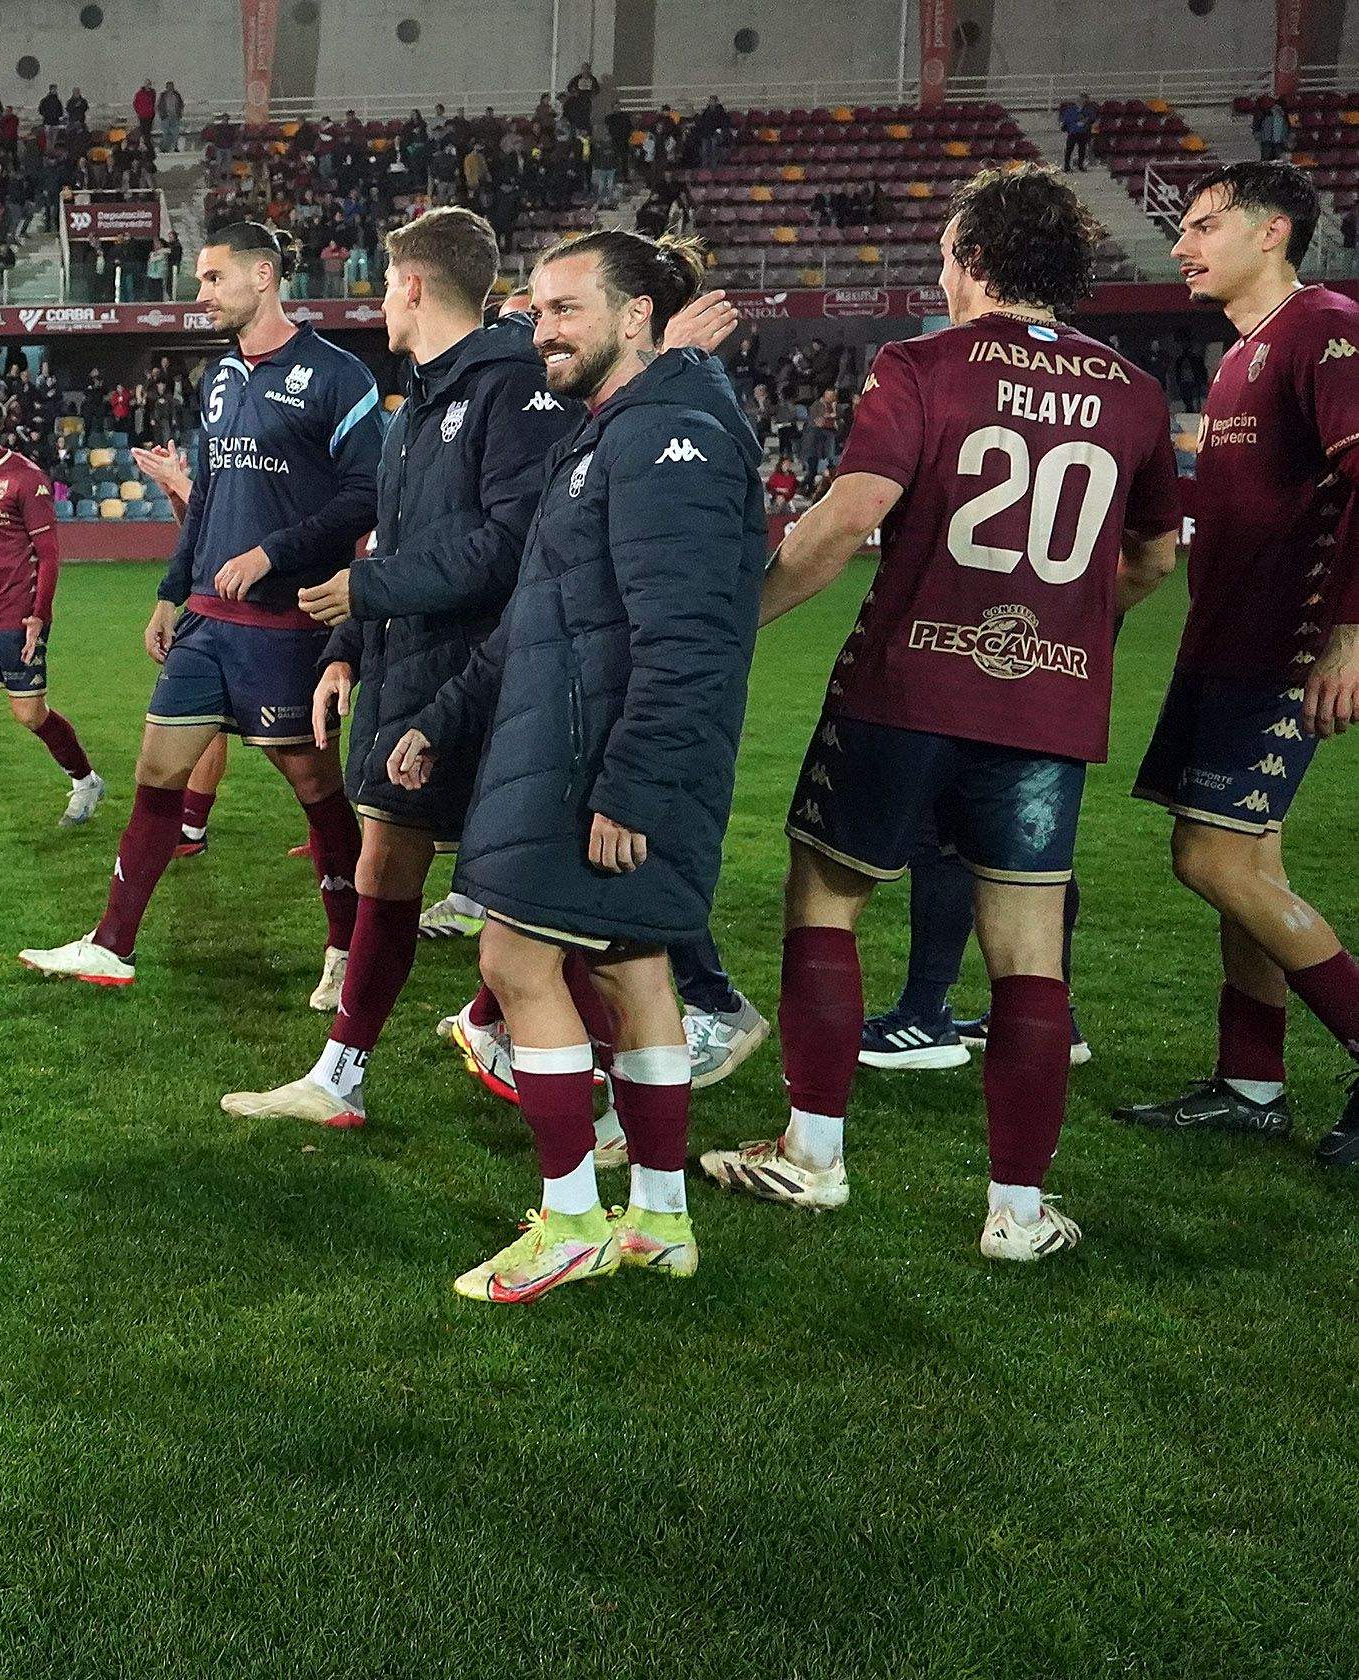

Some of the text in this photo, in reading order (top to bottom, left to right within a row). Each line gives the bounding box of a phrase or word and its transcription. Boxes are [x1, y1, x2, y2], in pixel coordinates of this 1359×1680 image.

[208, 384, 226, 424] 5
[997, 379, 1102, 429] PELAYO
[234, 454, 290, 475] GALICIA
[947, 425, 1118, 584] 20
[908, 620, 1089, 680] PESCAMAR
